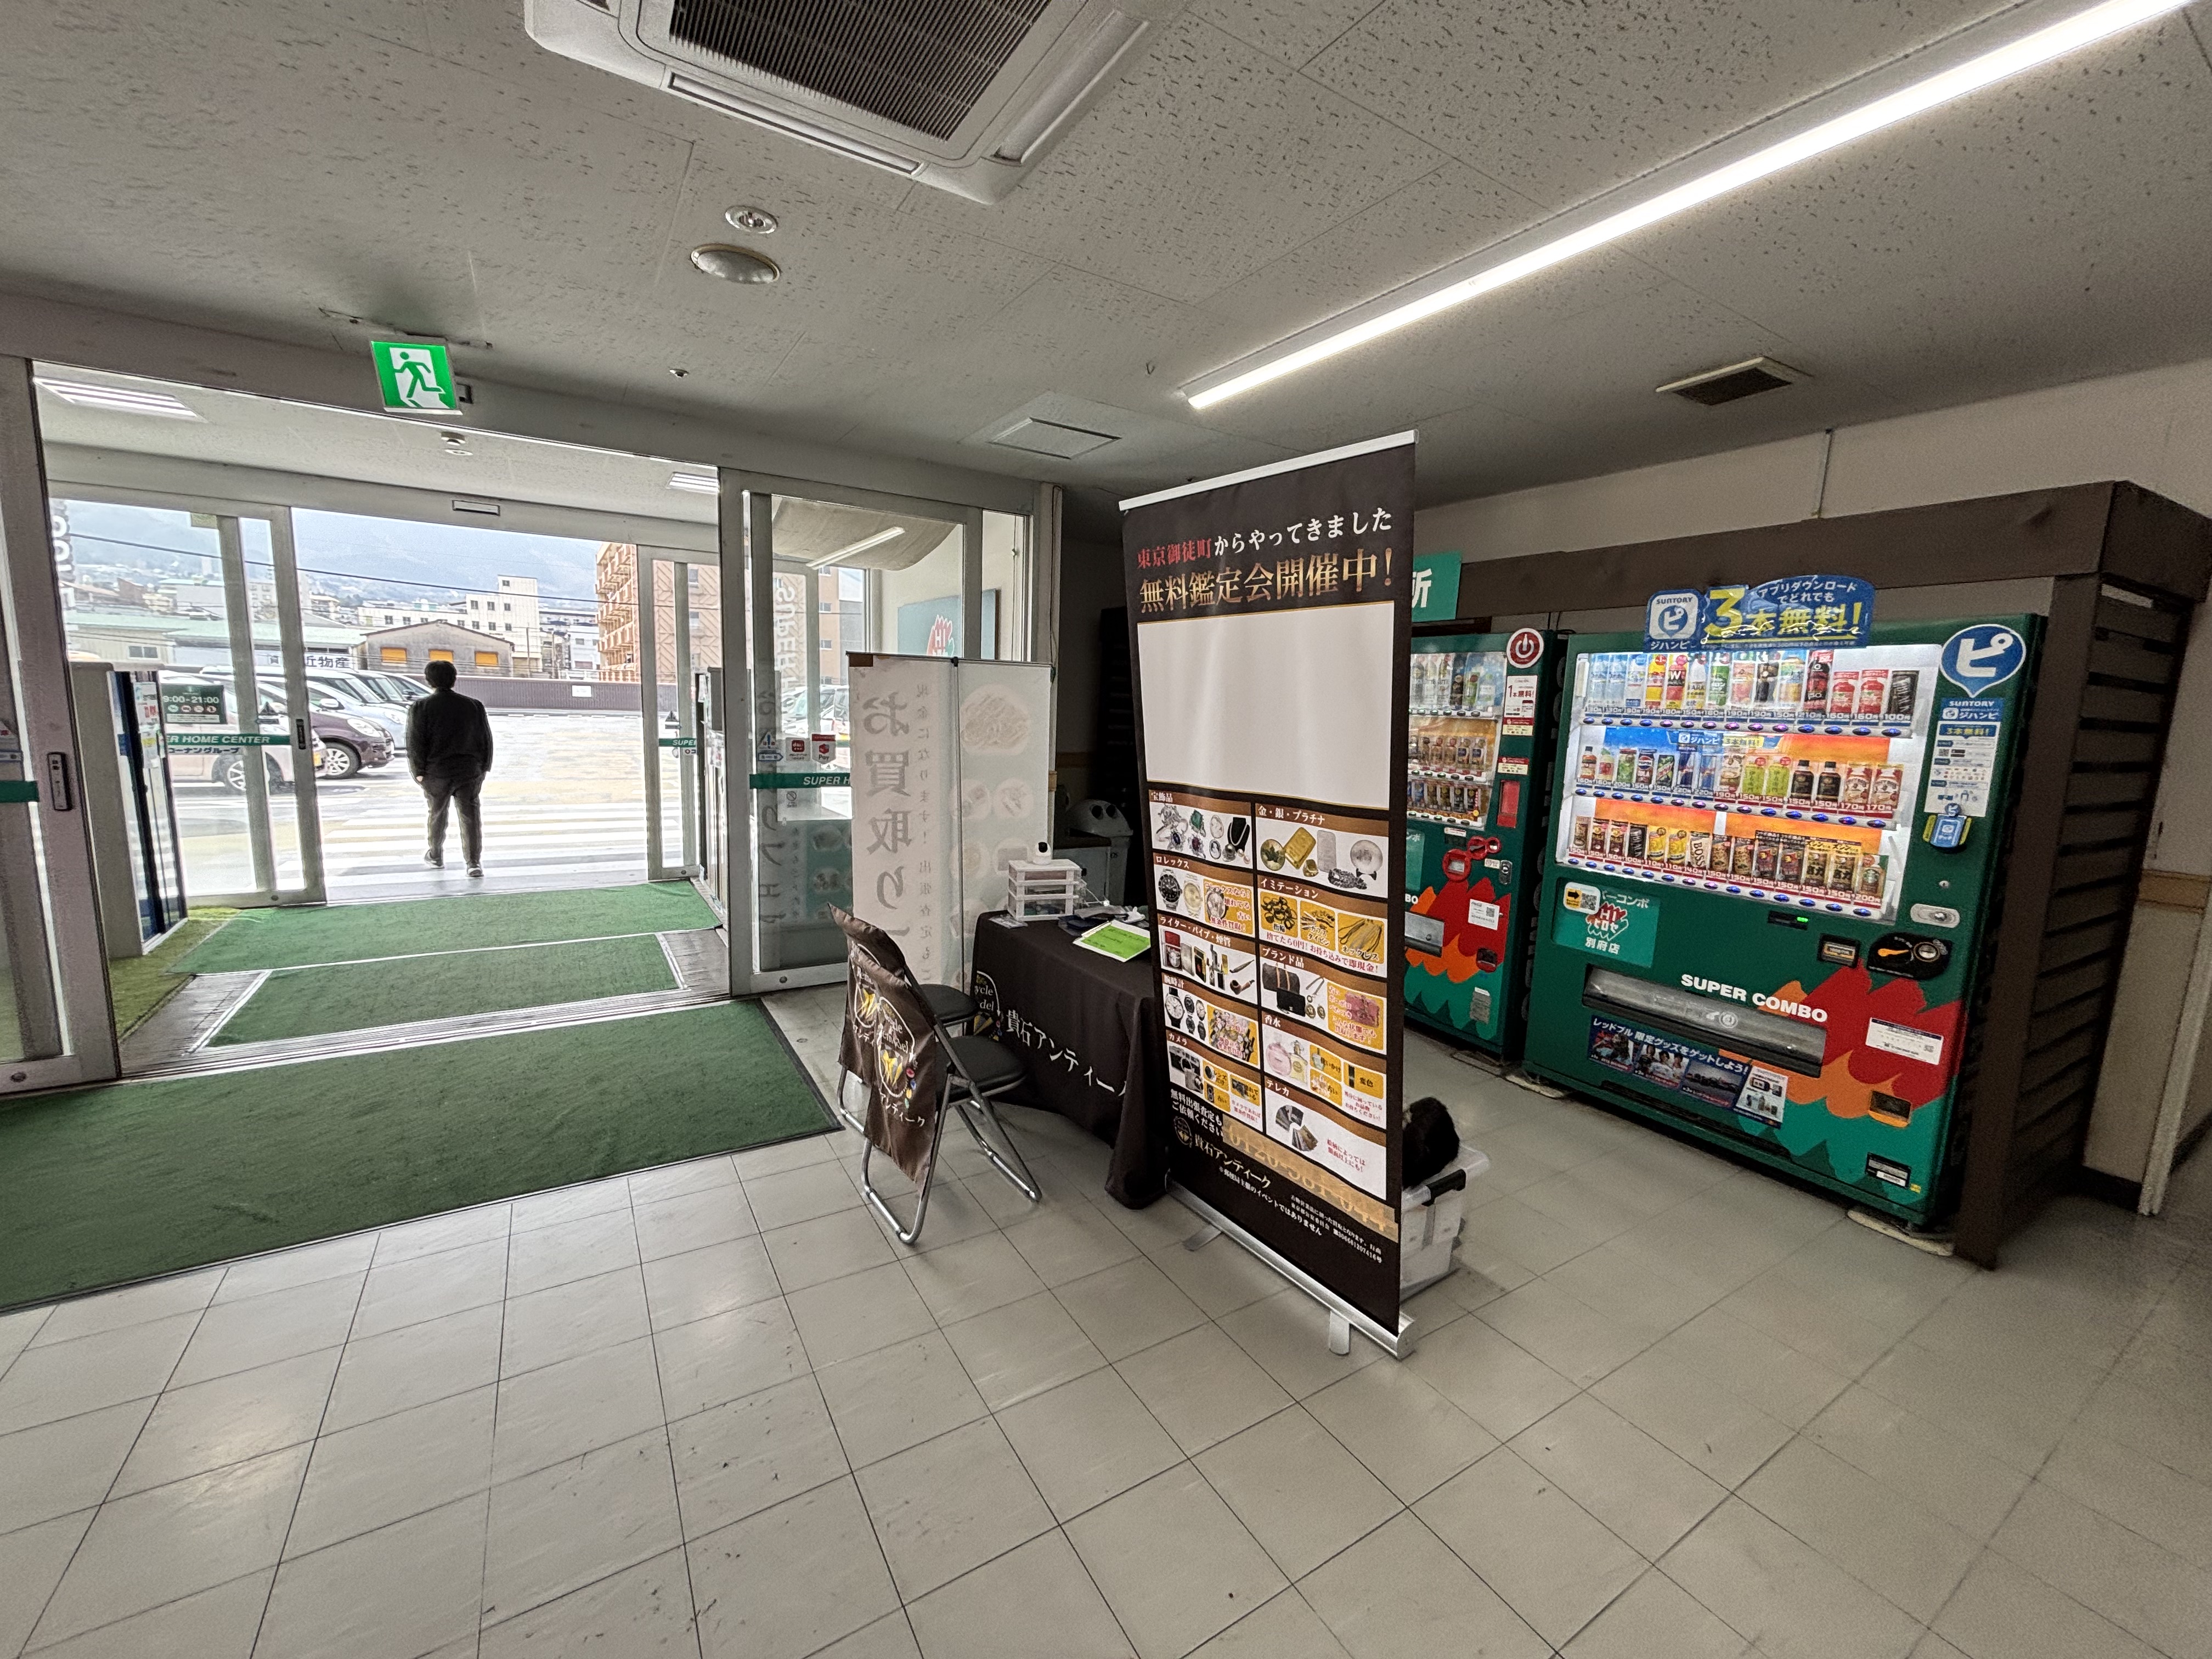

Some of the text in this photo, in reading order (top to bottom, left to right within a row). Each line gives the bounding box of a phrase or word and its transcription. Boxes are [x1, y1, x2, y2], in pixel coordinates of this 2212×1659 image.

[1137, 507, 1392, 569] 東京御徒町からやってきました
[1139, 548, 1393, 614] 無料鑑定会開催中!
[1758, 581, 1858, 599] アプリダウンロード
[1777, 592, 1835, 603] でどれでも
[803, 776, 840, 785] SUPER
[1257, 806, 1325, 826] 金・銀・プラチナ
[1155, 855, 1190, 870] ロレックス
[1693, 841, 1706, 868] BOSS
[1261, 878, 1319, 899] イミテーション
[1585, 936, 1620, 955] 別府店
[1262, 948, 1305, 969] ブランド品
[1681, 974, 1829, 1022] SUPER COMBO
[1264, 1014, 1282, 1028] 香水
[1169, 1032, 1188, 1046] カメラ
[1593, 1018, 1633, 1037] レッドブル
[1634, 1031, 1749, 1075] 限定グッズをゲットしよう!
[1266, 1080, 1290, 1097] テレカ
